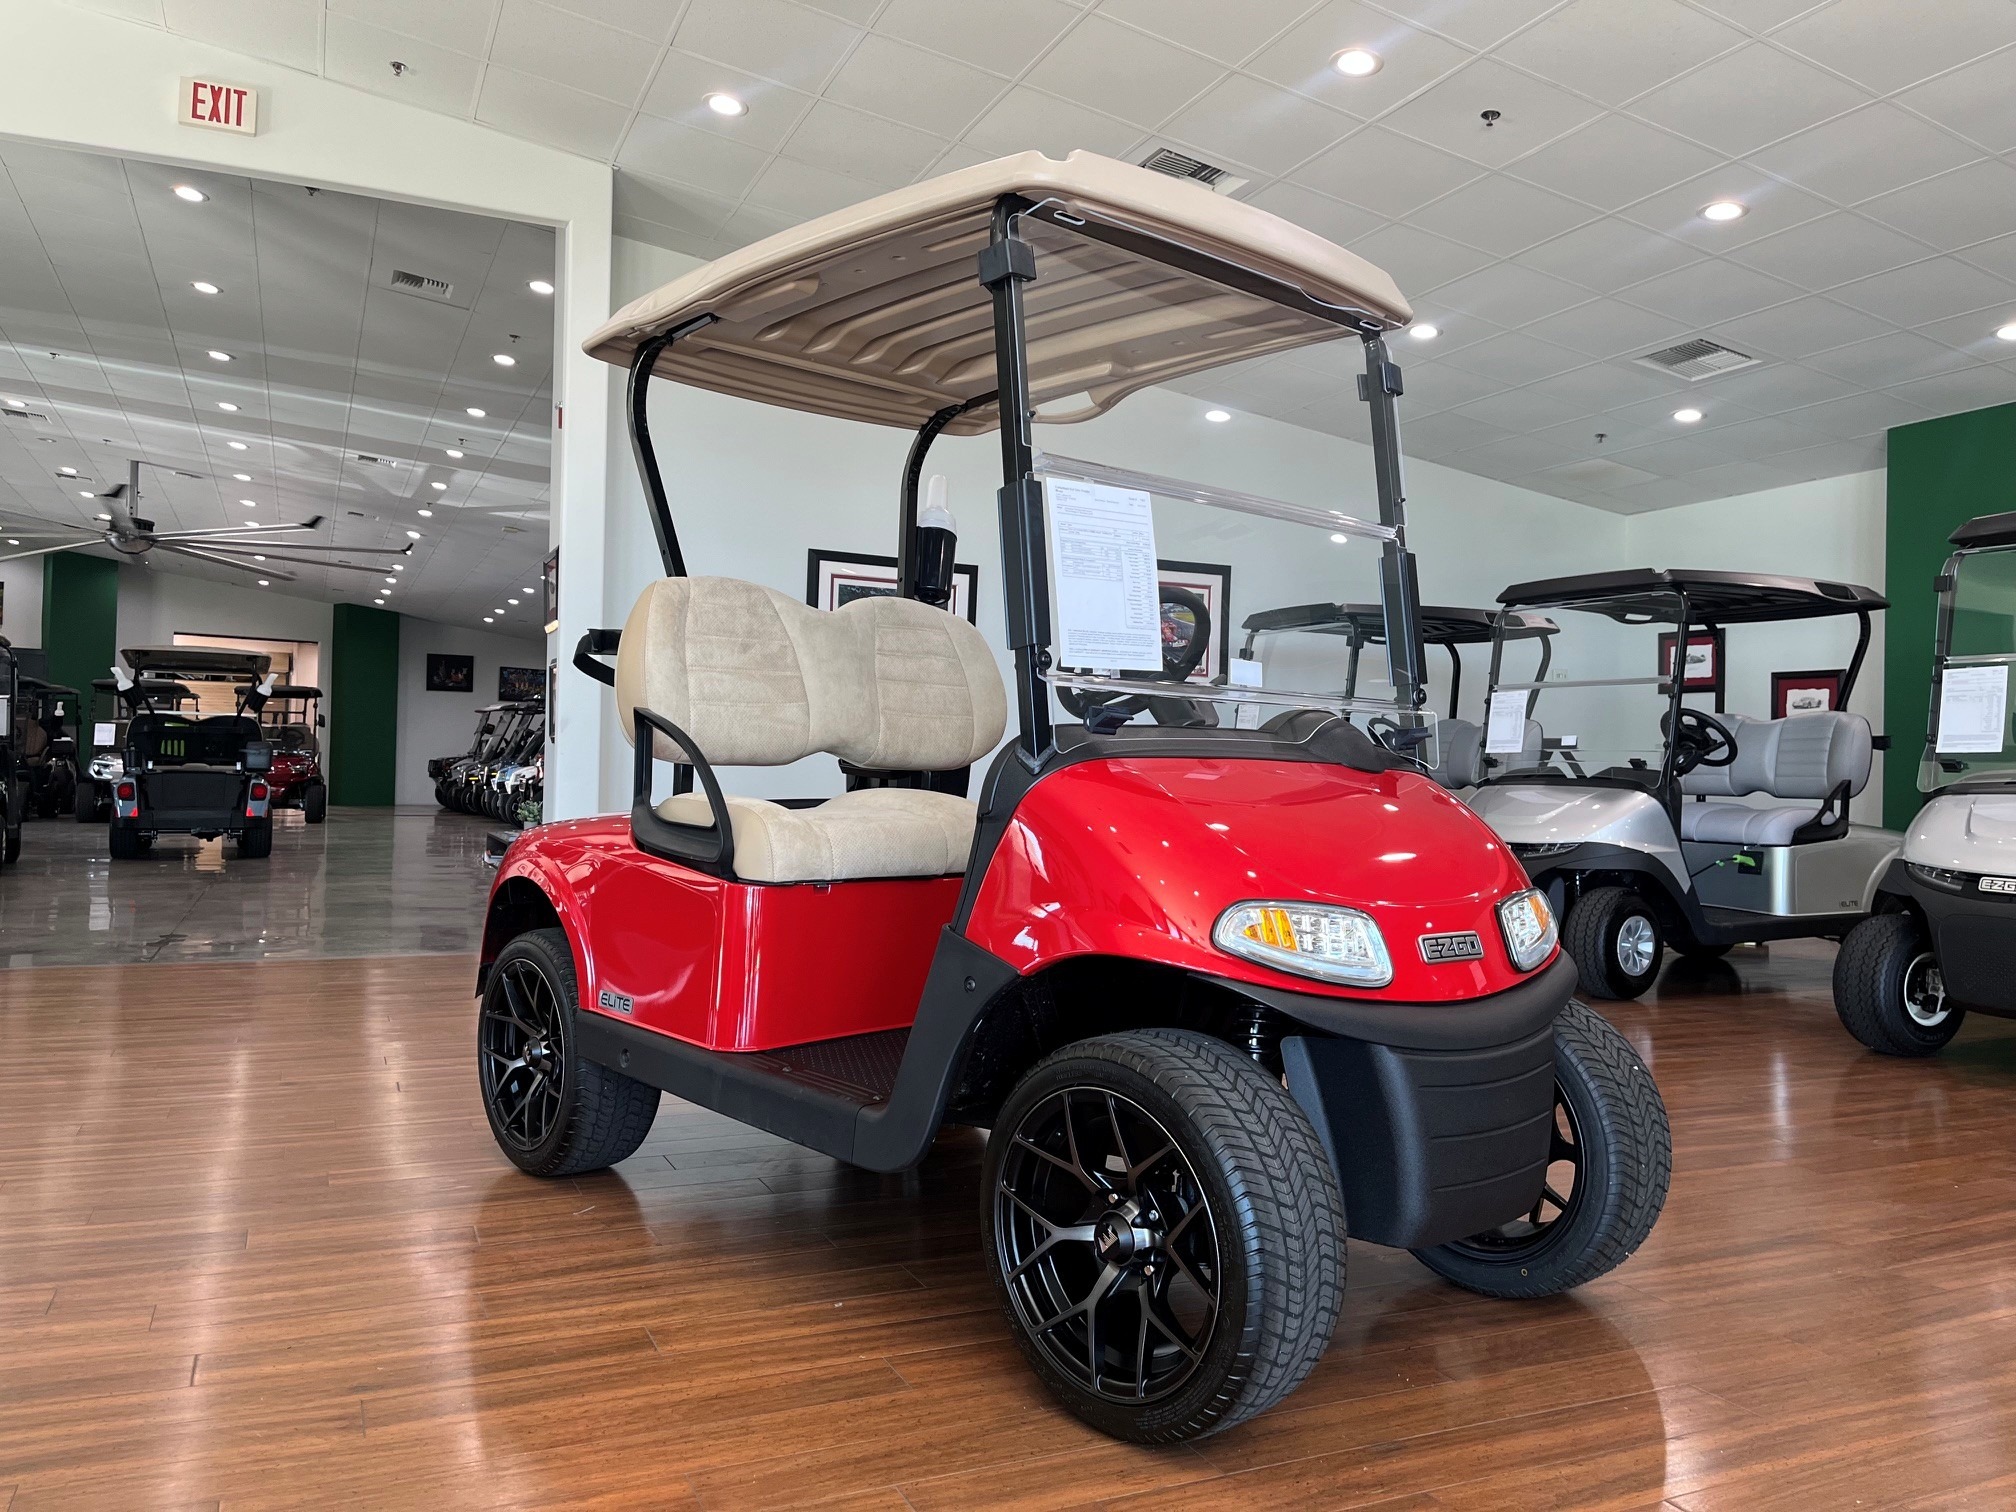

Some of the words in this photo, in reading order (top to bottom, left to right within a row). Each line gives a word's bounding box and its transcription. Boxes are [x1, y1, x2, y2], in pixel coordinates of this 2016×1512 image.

[191, 81, 248, 127] EXIT
[1981, 879, 2016, 891] EZG
[1424, 935, 1482, 959] EZGO
